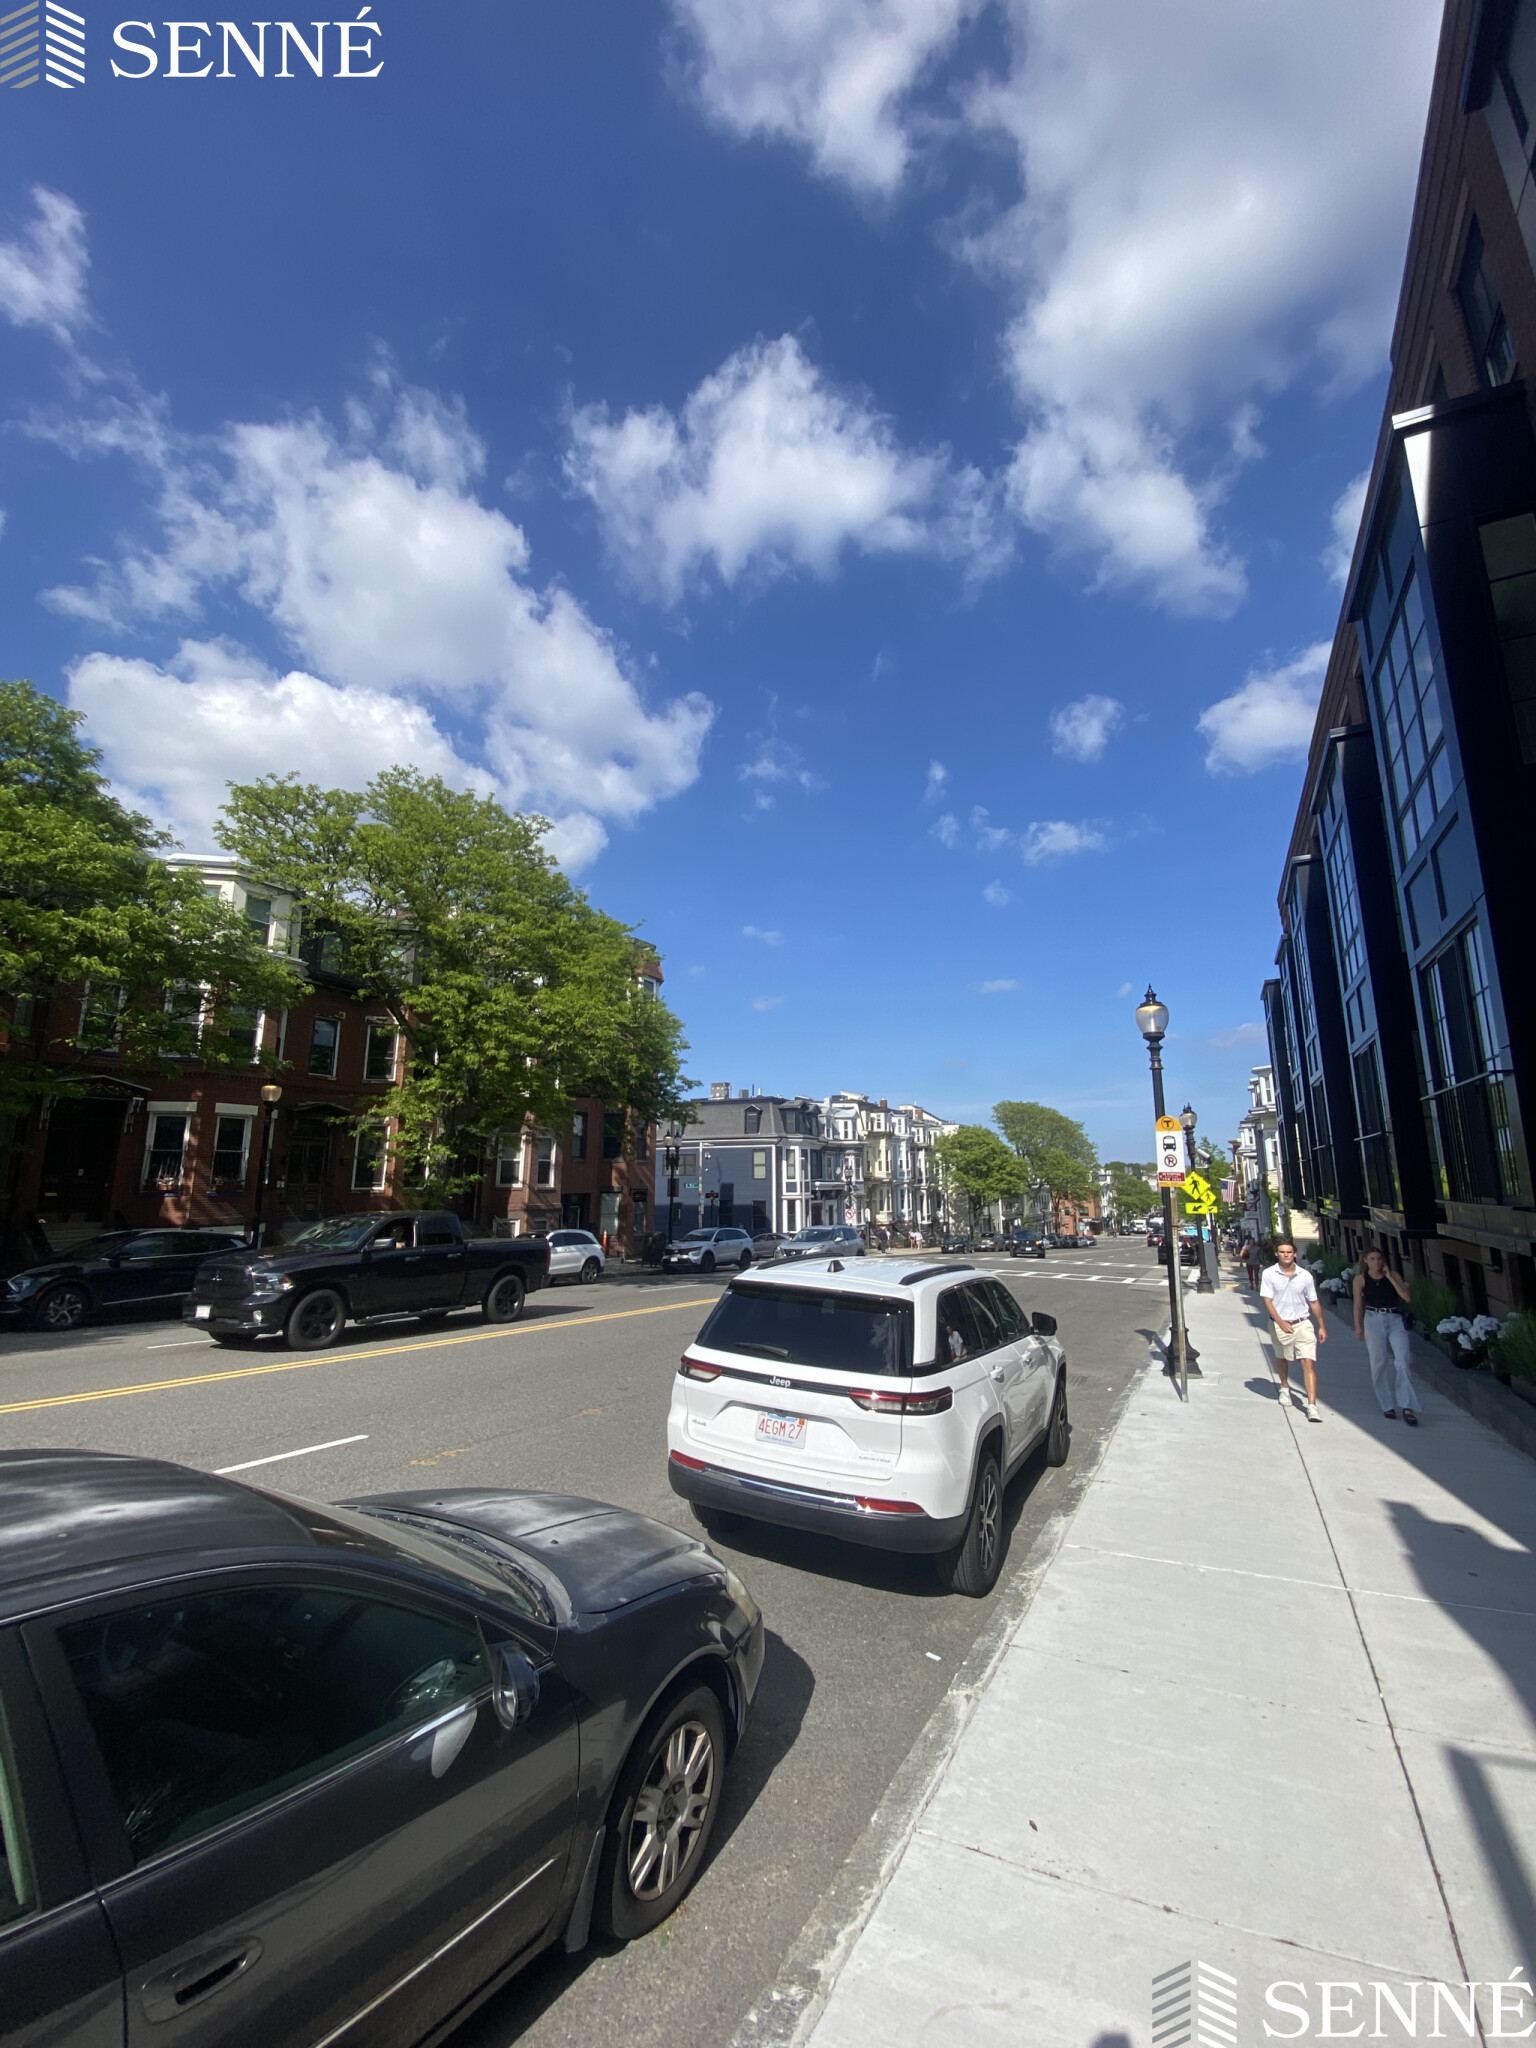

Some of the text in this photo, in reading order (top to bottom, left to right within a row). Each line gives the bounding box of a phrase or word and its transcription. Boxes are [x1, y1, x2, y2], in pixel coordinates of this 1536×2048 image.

[769, 1375, 791, 1389] Jeep
[758, 1418, 787, 1438] 4EGM
[788, 1423, 803, 1440] 27
